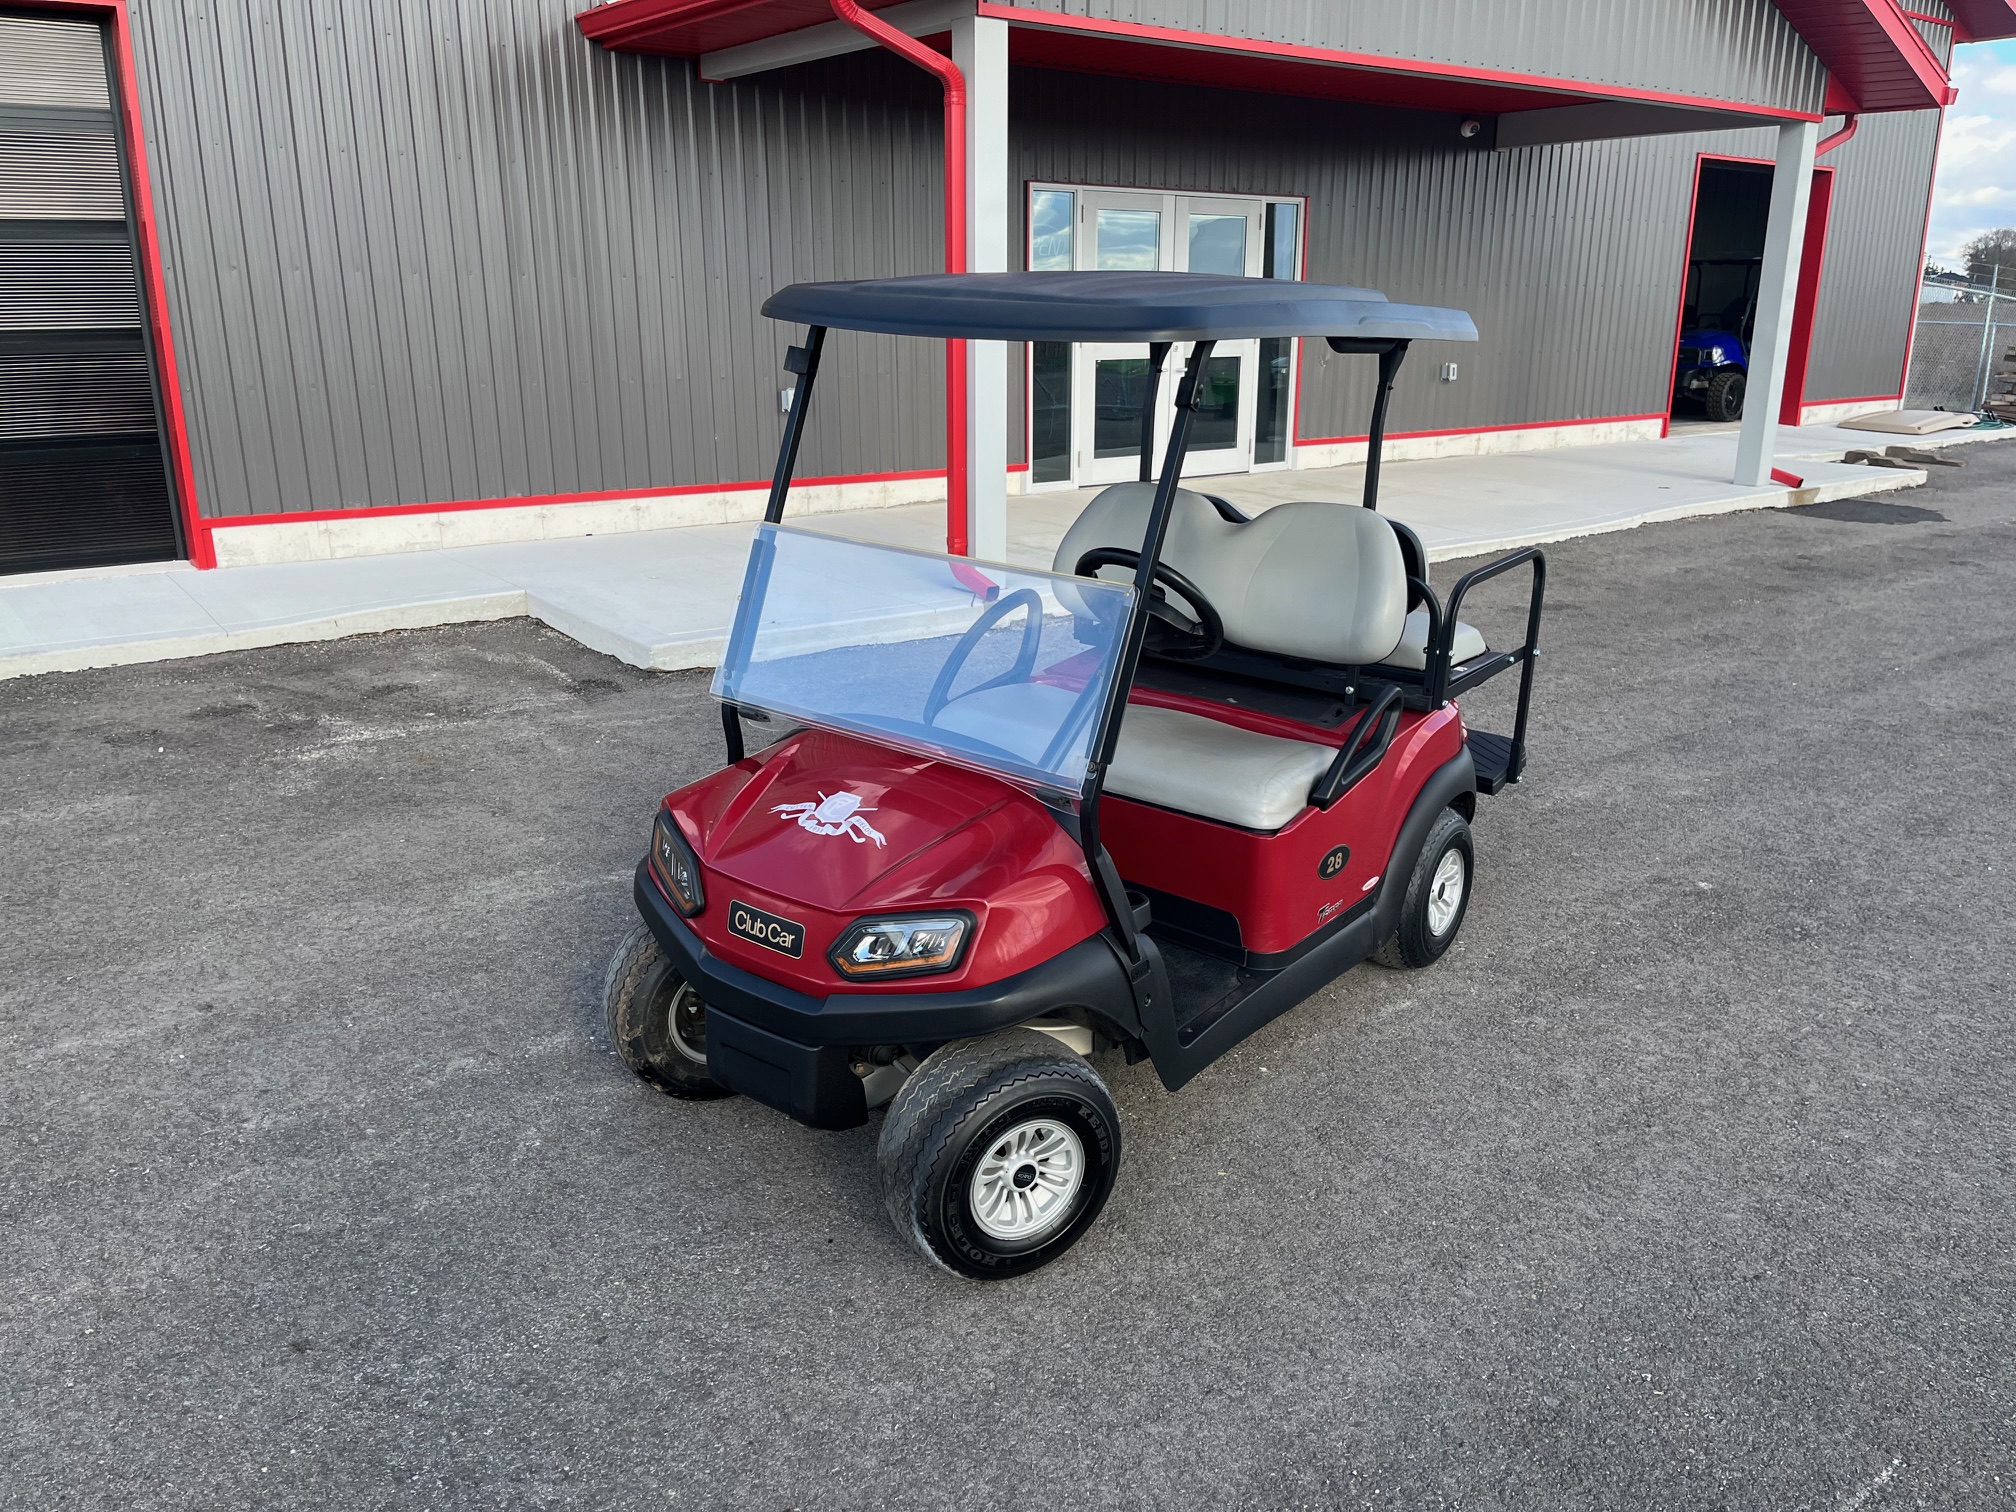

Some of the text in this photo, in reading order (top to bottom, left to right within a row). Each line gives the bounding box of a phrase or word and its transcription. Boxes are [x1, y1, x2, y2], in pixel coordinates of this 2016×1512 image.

[856, 818, 874, 835] FIELDS
[1326, 852, 1343, 874] 28
[735, 910, 796, 949] Club Car
[1078, 1105, 1110, 1166] KENDA
